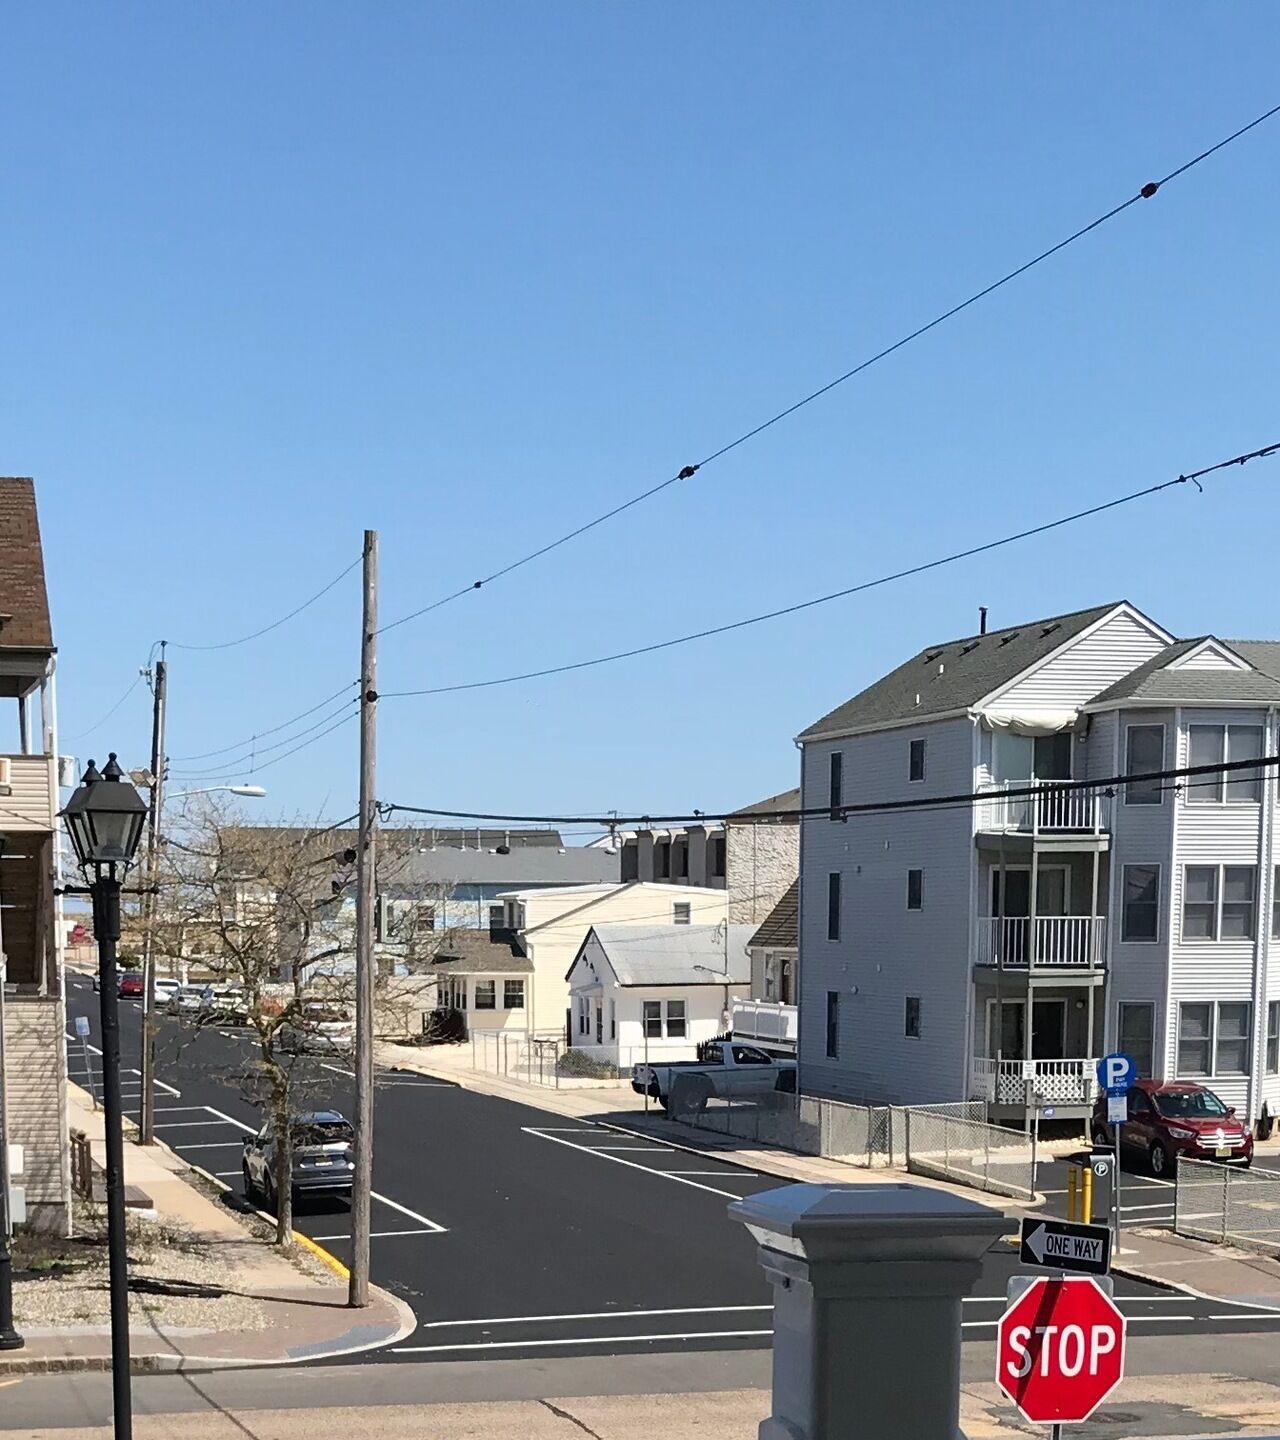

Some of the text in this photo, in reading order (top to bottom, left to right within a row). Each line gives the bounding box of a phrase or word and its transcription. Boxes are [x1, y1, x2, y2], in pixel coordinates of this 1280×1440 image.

[1046, 1235, 1100, 1260] ONE WAY
[1006, 1324, 1116, 1378] STOP
